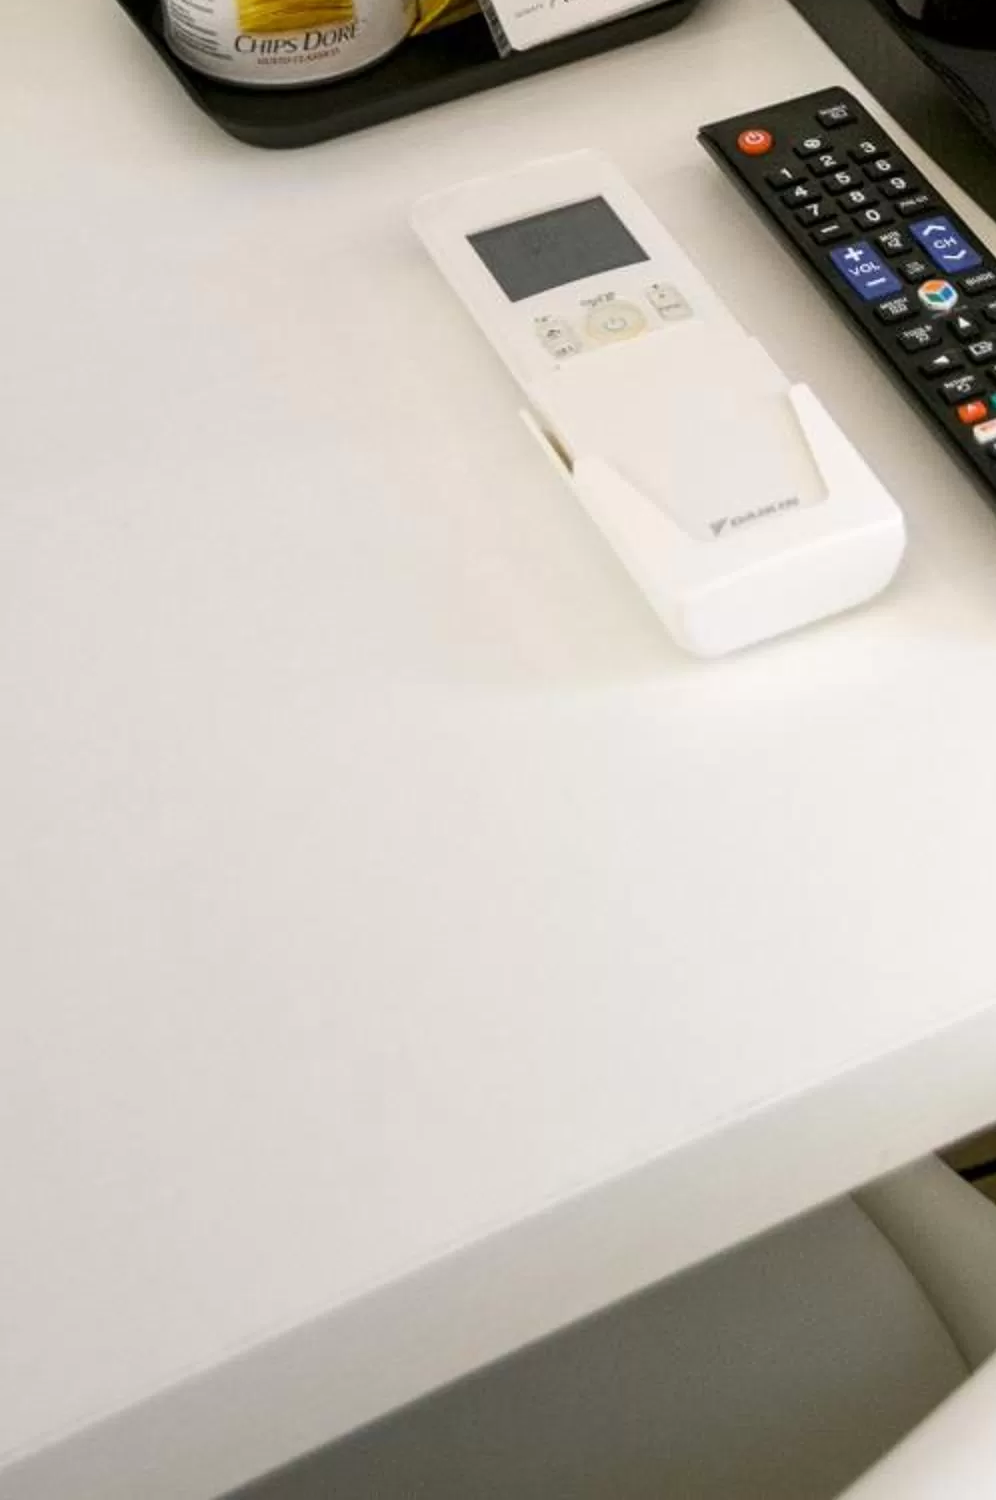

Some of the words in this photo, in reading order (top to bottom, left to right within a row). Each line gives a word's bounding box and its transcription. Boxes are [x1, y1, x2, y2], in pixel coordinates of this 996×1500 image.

[234, 34, 298, 53] CHIPS
[781, 168, 793, 179] 1
[819, 155, 837, 167] 2
[860, 141, 876, 154] 3
[794, 186, 809, 198] 4
[835, 172, 851, 184] 5
[874, 159, 891, 171] 6
[806, 203, 819, 216] 7
[850, 191, 865, 203] 8
[890, 177, 907, 189] 9
[865, 209, 881, 222] 0
[933, 235, 958, 250] CH
[848, 261, 881, 276] VOL
